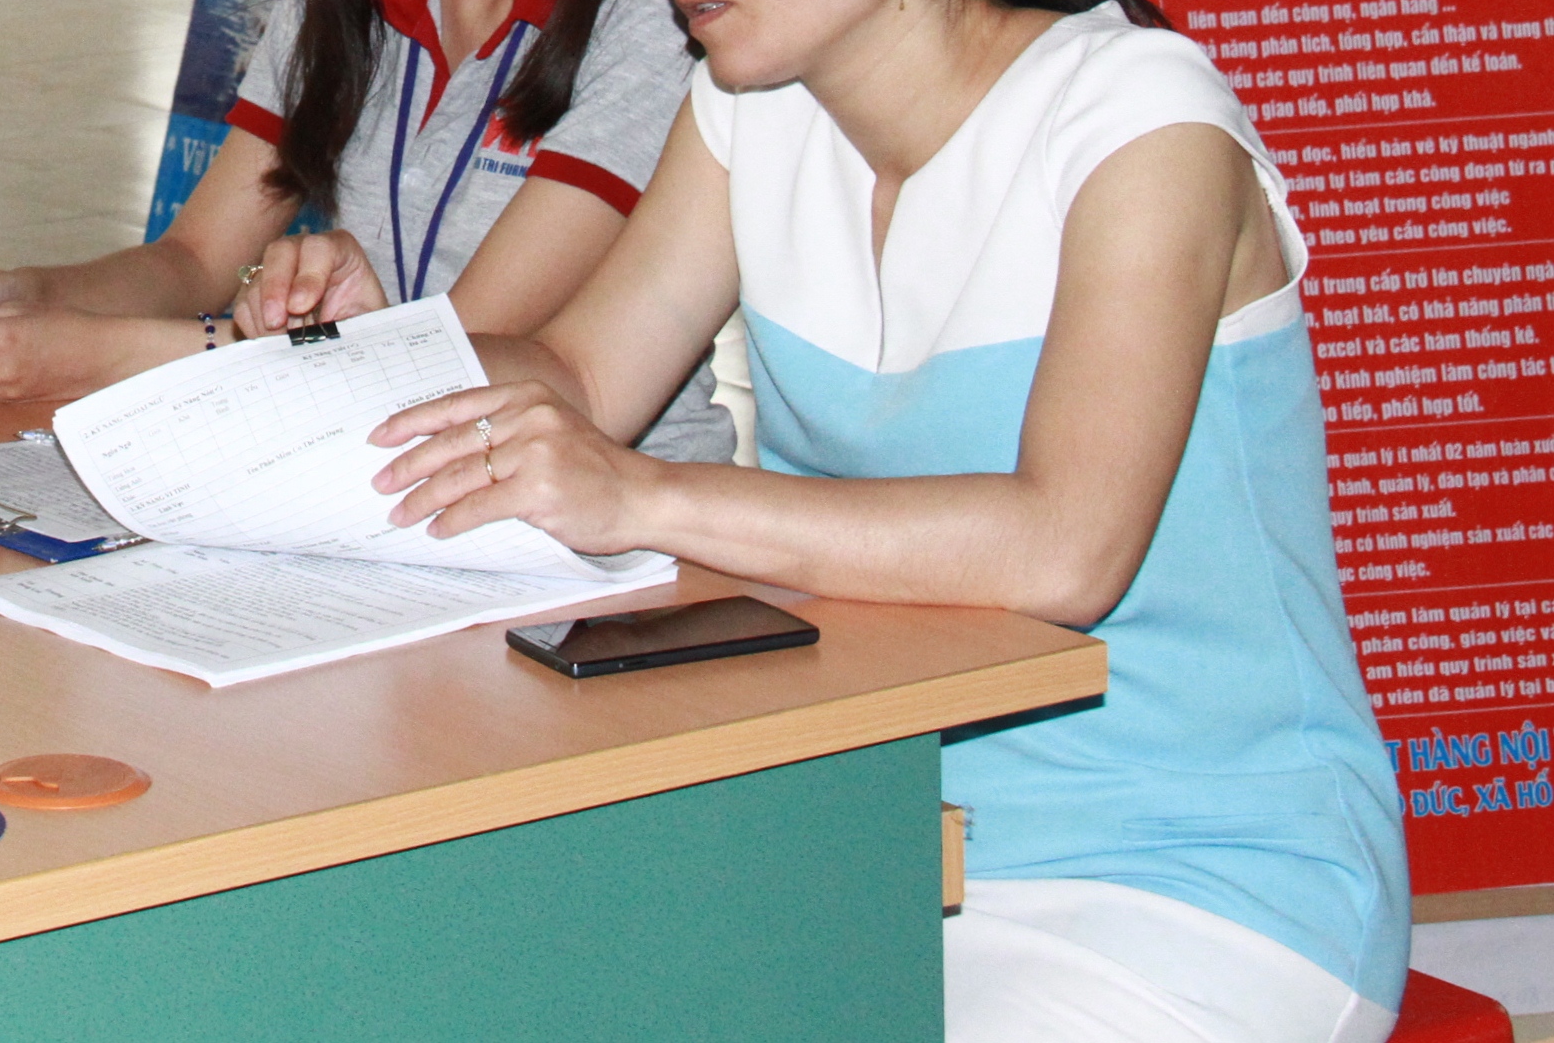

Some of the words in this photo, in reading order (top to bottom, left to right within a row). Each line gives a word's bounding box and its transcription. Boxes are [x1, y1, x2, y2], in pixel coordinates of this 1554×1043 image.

[1408, 727, 1492, 772] HÀNG
[1498, 719, 1551, 770] NỘI
[1410, 780, 1470, 817] ĐỨC,
[1473, 776, 1513, 813] XÃ
